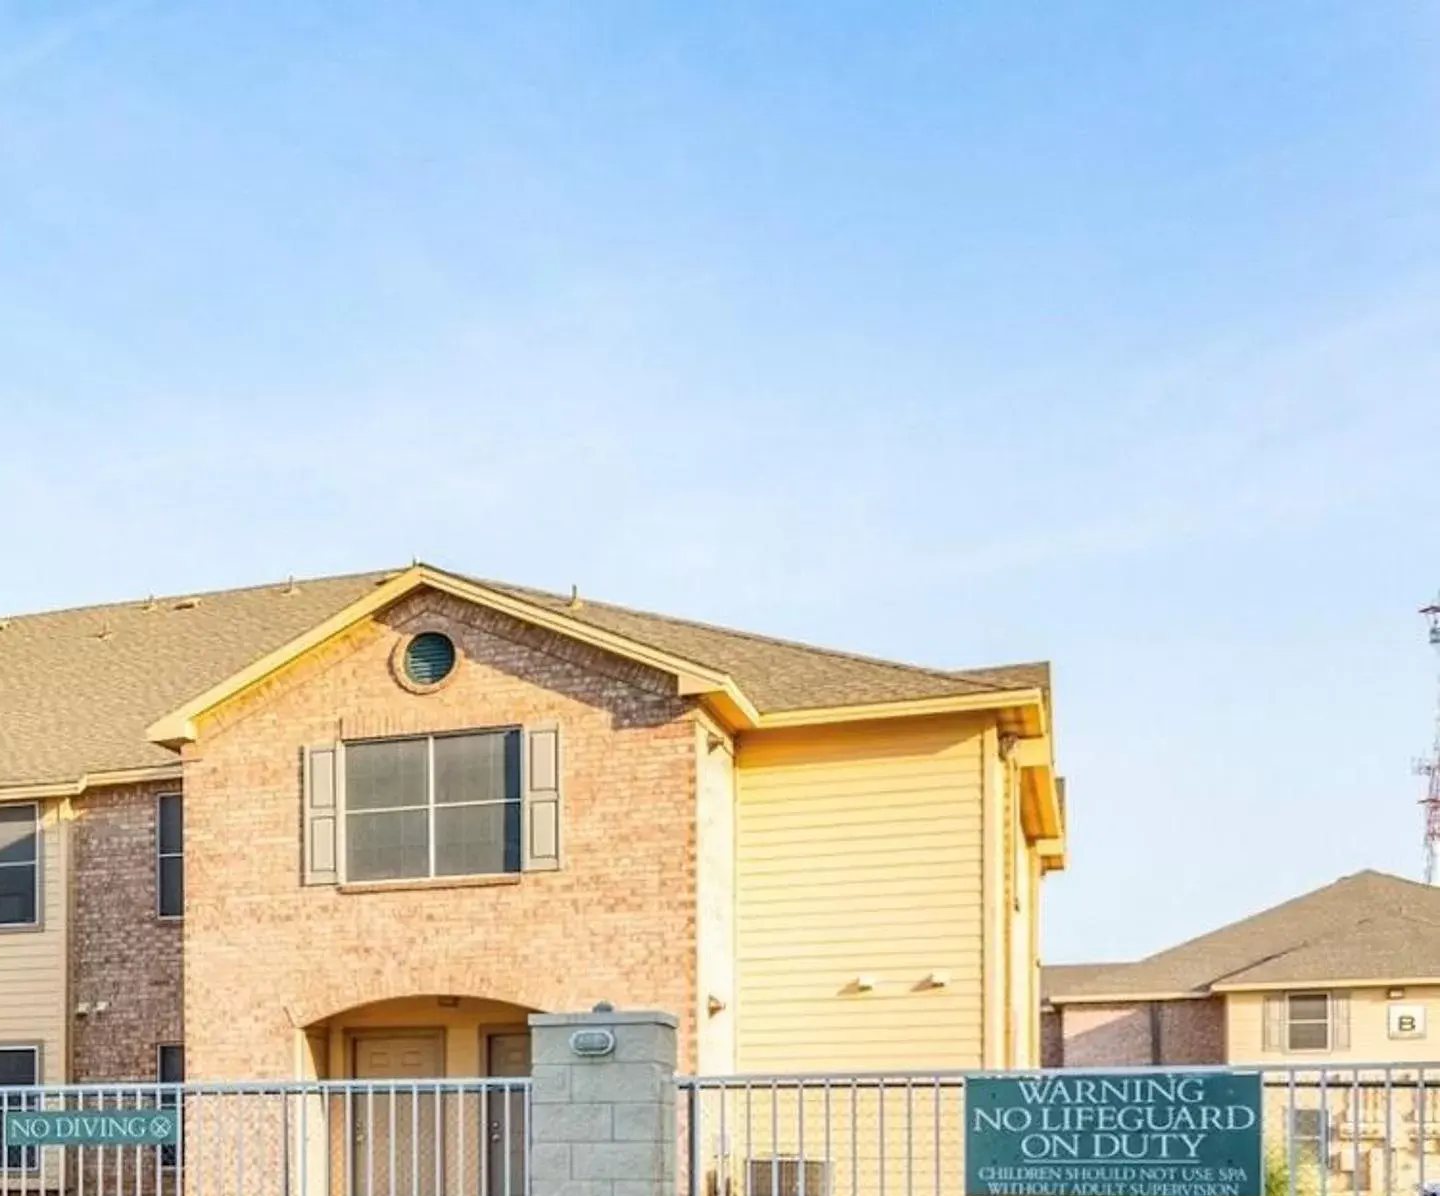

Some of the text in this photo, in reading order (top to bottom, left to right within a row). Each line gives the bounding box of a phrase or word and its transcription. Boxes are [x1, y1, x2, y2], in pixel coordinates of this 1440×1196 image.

[1398, 1015, 1416, 1031] B
[1018, 1078, 1205, 1104] WARNING
[11, 1116, 146, 1138] NO DIVING
[972, 1105, 1256, 1132] NO LIFEGUARD
[1021, 1133, 1207, 1158] ON DUTY
[978, 1166, 1247, 1182] CHILDREN SHOULD NOT USE SPA
[987, 1182, 1240, 1196] WITHOUT ADULT SUPERVISION
